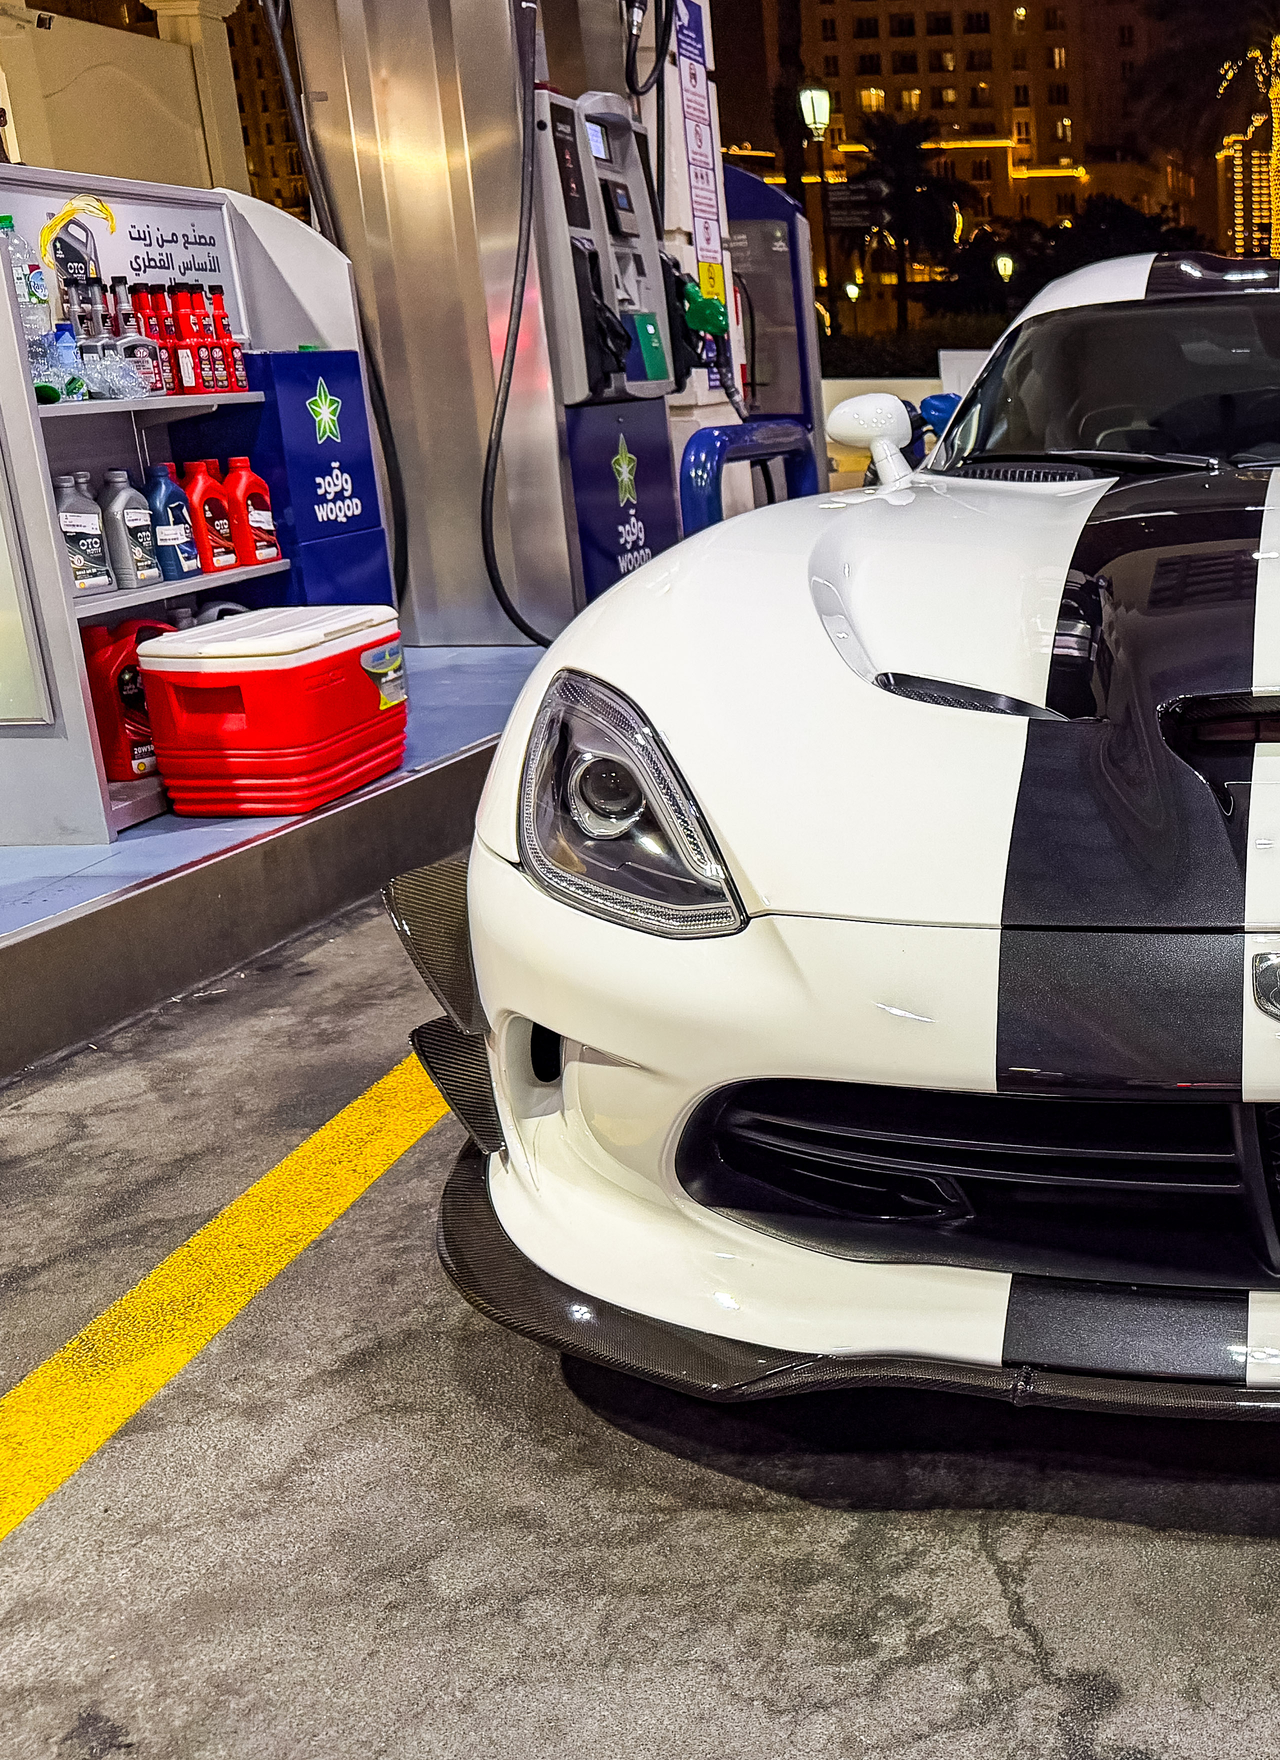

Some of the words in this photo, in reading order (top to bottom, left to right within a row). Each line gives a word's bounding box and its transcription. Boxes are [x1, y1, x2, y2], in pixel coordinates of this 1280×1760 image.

[128, 224, 153, 247] زيت
[156, 227, 178, 248] من
[67, 262, 85, 273] OTO
[129, 251, 175, 277] القطري
[178, 252, 221, 276] الأساس
[315, 461, 352, 500] وقود
[314, 497, 362, 522] WOQOD
[214, 519, 229, 530] OTO
[617, 508, 645, 550] وقود
[79, 537, 100, 550] OTO
[137, 531, 151, 543] OTO
